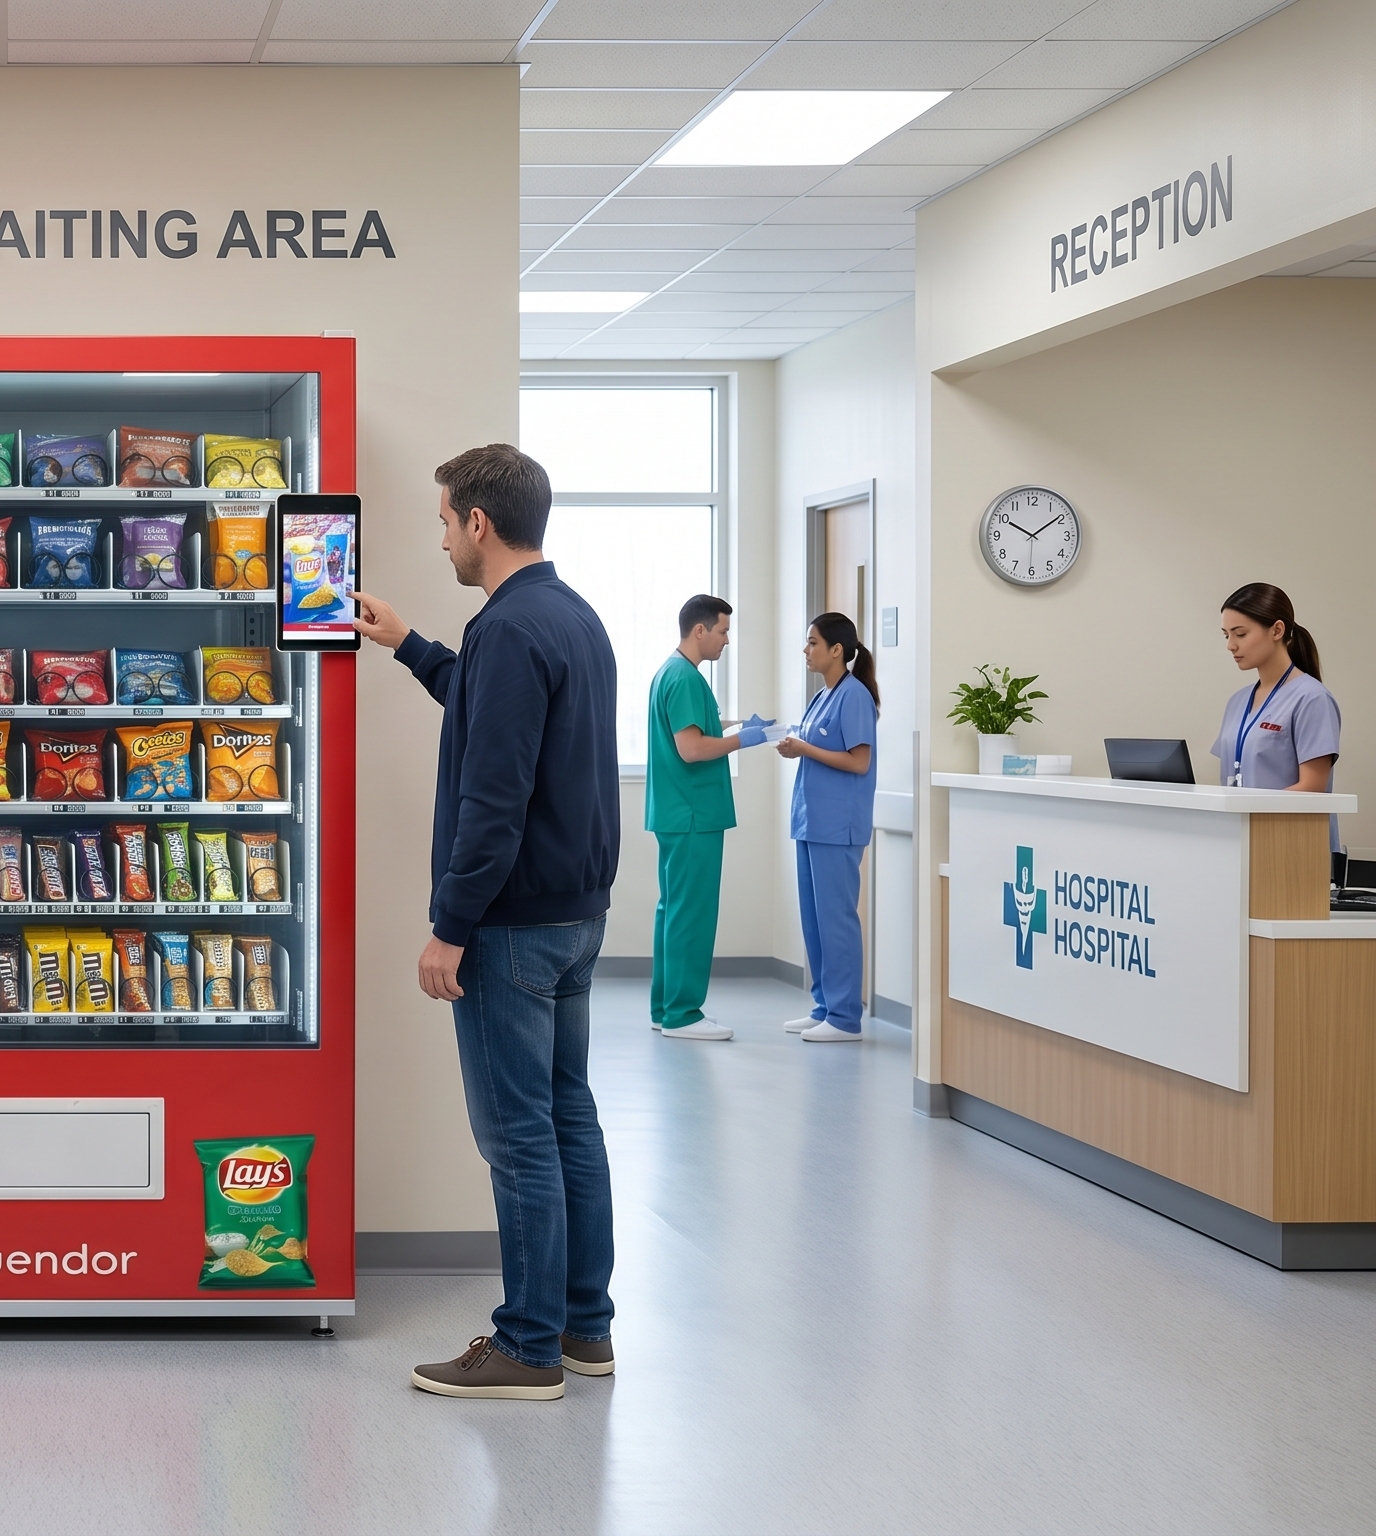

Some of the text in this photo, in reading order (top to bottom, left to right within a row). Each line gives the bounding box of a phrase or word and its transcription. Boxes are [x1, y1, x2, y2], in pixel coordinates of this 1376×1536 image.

[1050, 154, 1233, 294] RECEPTION
[215, 209, 397, 259] AREA
[1011, 501, 1019, 512] 11
[1027, 496, 1039, 506] 12
[998, 513, 1010, 524] 10
[1057, 514, 1065, 525] 2
[993, 530, 1001, 541] 9
[1063, 531, 1071, 541] 3
[999, 549, 1007, 559] 8
[1057, 549, 1065, 558] 4
[1012, 560, 1019, 571] 7
[1028, 566, 1035, 576] 6
[1046, 560, 1053, 571] 5
[1054, 869, 1156, 926] HOSPITAL
[1054, 917, 1156, 979] HOSPITAL
[222, 1158, 288, 1191] Lay's
